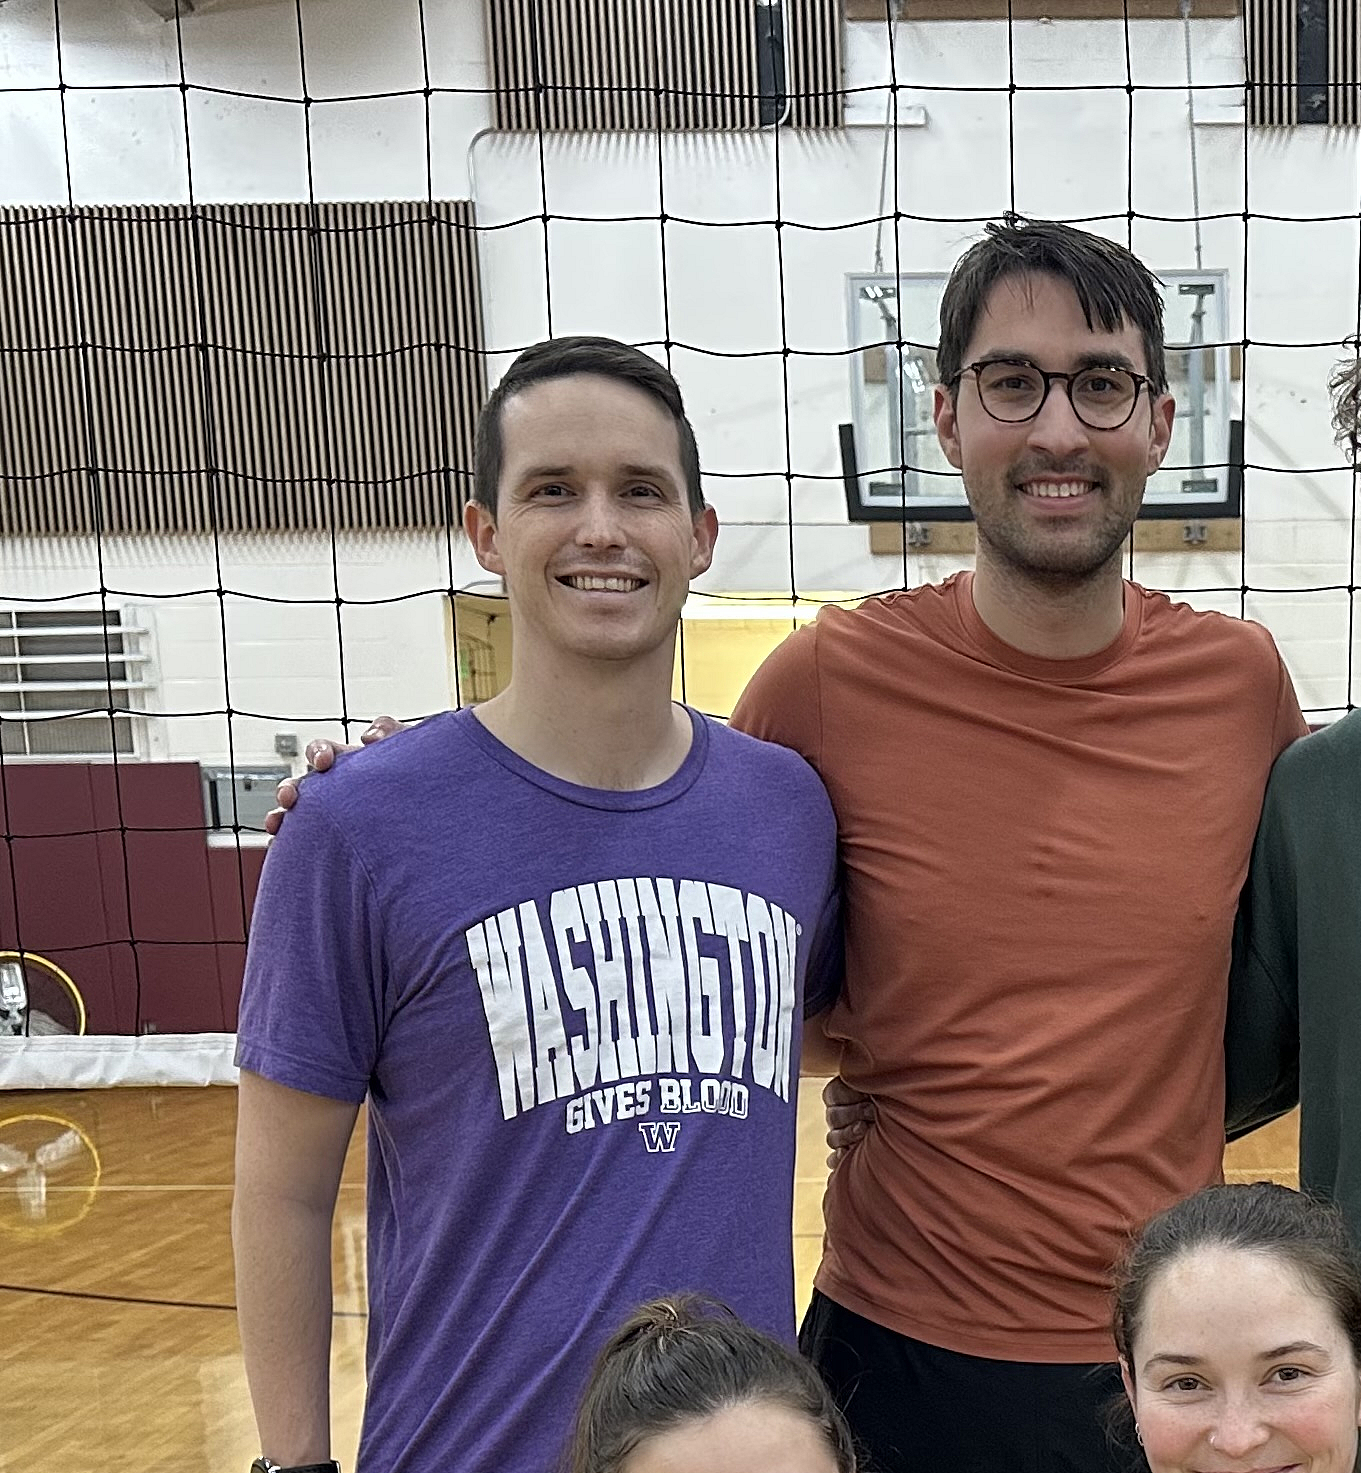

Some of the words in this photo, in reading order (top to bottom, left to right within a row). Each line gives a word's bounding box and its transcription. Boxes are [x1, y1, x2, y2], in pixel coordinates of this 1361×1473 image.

[465, 877, 796, 1120] WASHINGTON
[566, 1080, 652, 1134] GIVES
[658, 1078, 749, 1119] BLOOD
[639, 1122, 680, 1152] W
